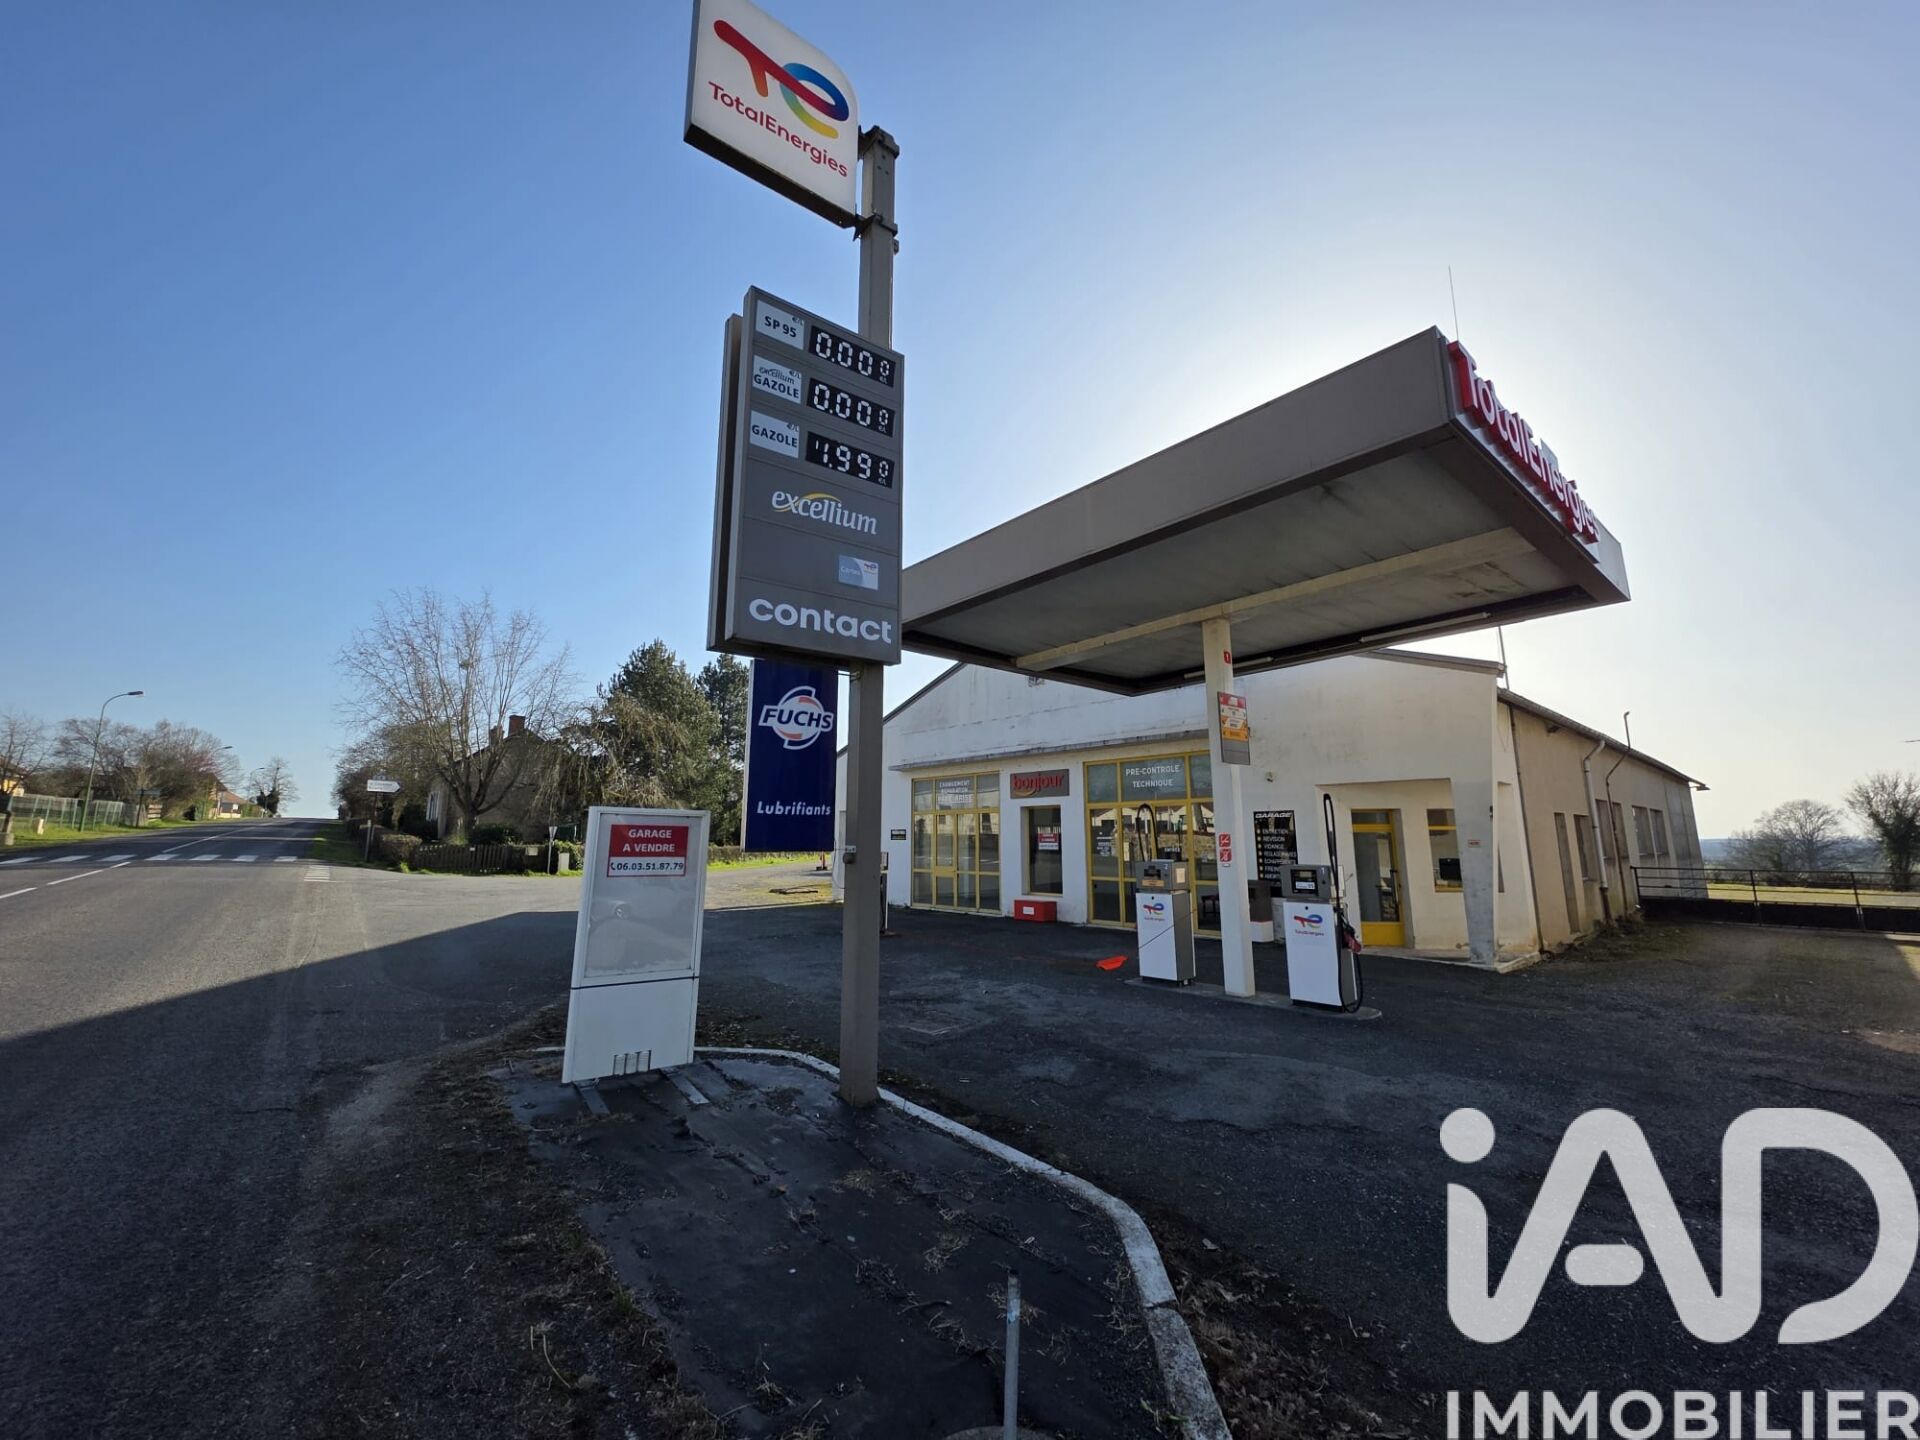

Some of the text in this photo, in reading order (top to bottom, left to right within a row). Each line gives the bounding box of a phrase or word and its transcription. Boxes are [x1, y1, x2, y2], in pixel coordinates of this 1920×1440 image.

[708, 81, 848, 178] TotalEnergies
[764, 315, 797, 338] SP 95
[754, 374, 800, 399] GAZOLE
[752, 425, 798, 448] GAZOLE
[771, 490, 877, 535] excellium
[748, 598, 892, 645] contact
[762, 707, 833, 730] FUCHS
[1012, 773, 1066, 792] bonjour
[1132, 779, 1174, 789] TECHNIQUE
[756, 801, 832, 816] Lubrifiants
[628, 828, 672, 839] GARAGE
[622, 843, 676, 853] A VENDRE
[616, 862, 684, 871] 06.03.51.87.79
